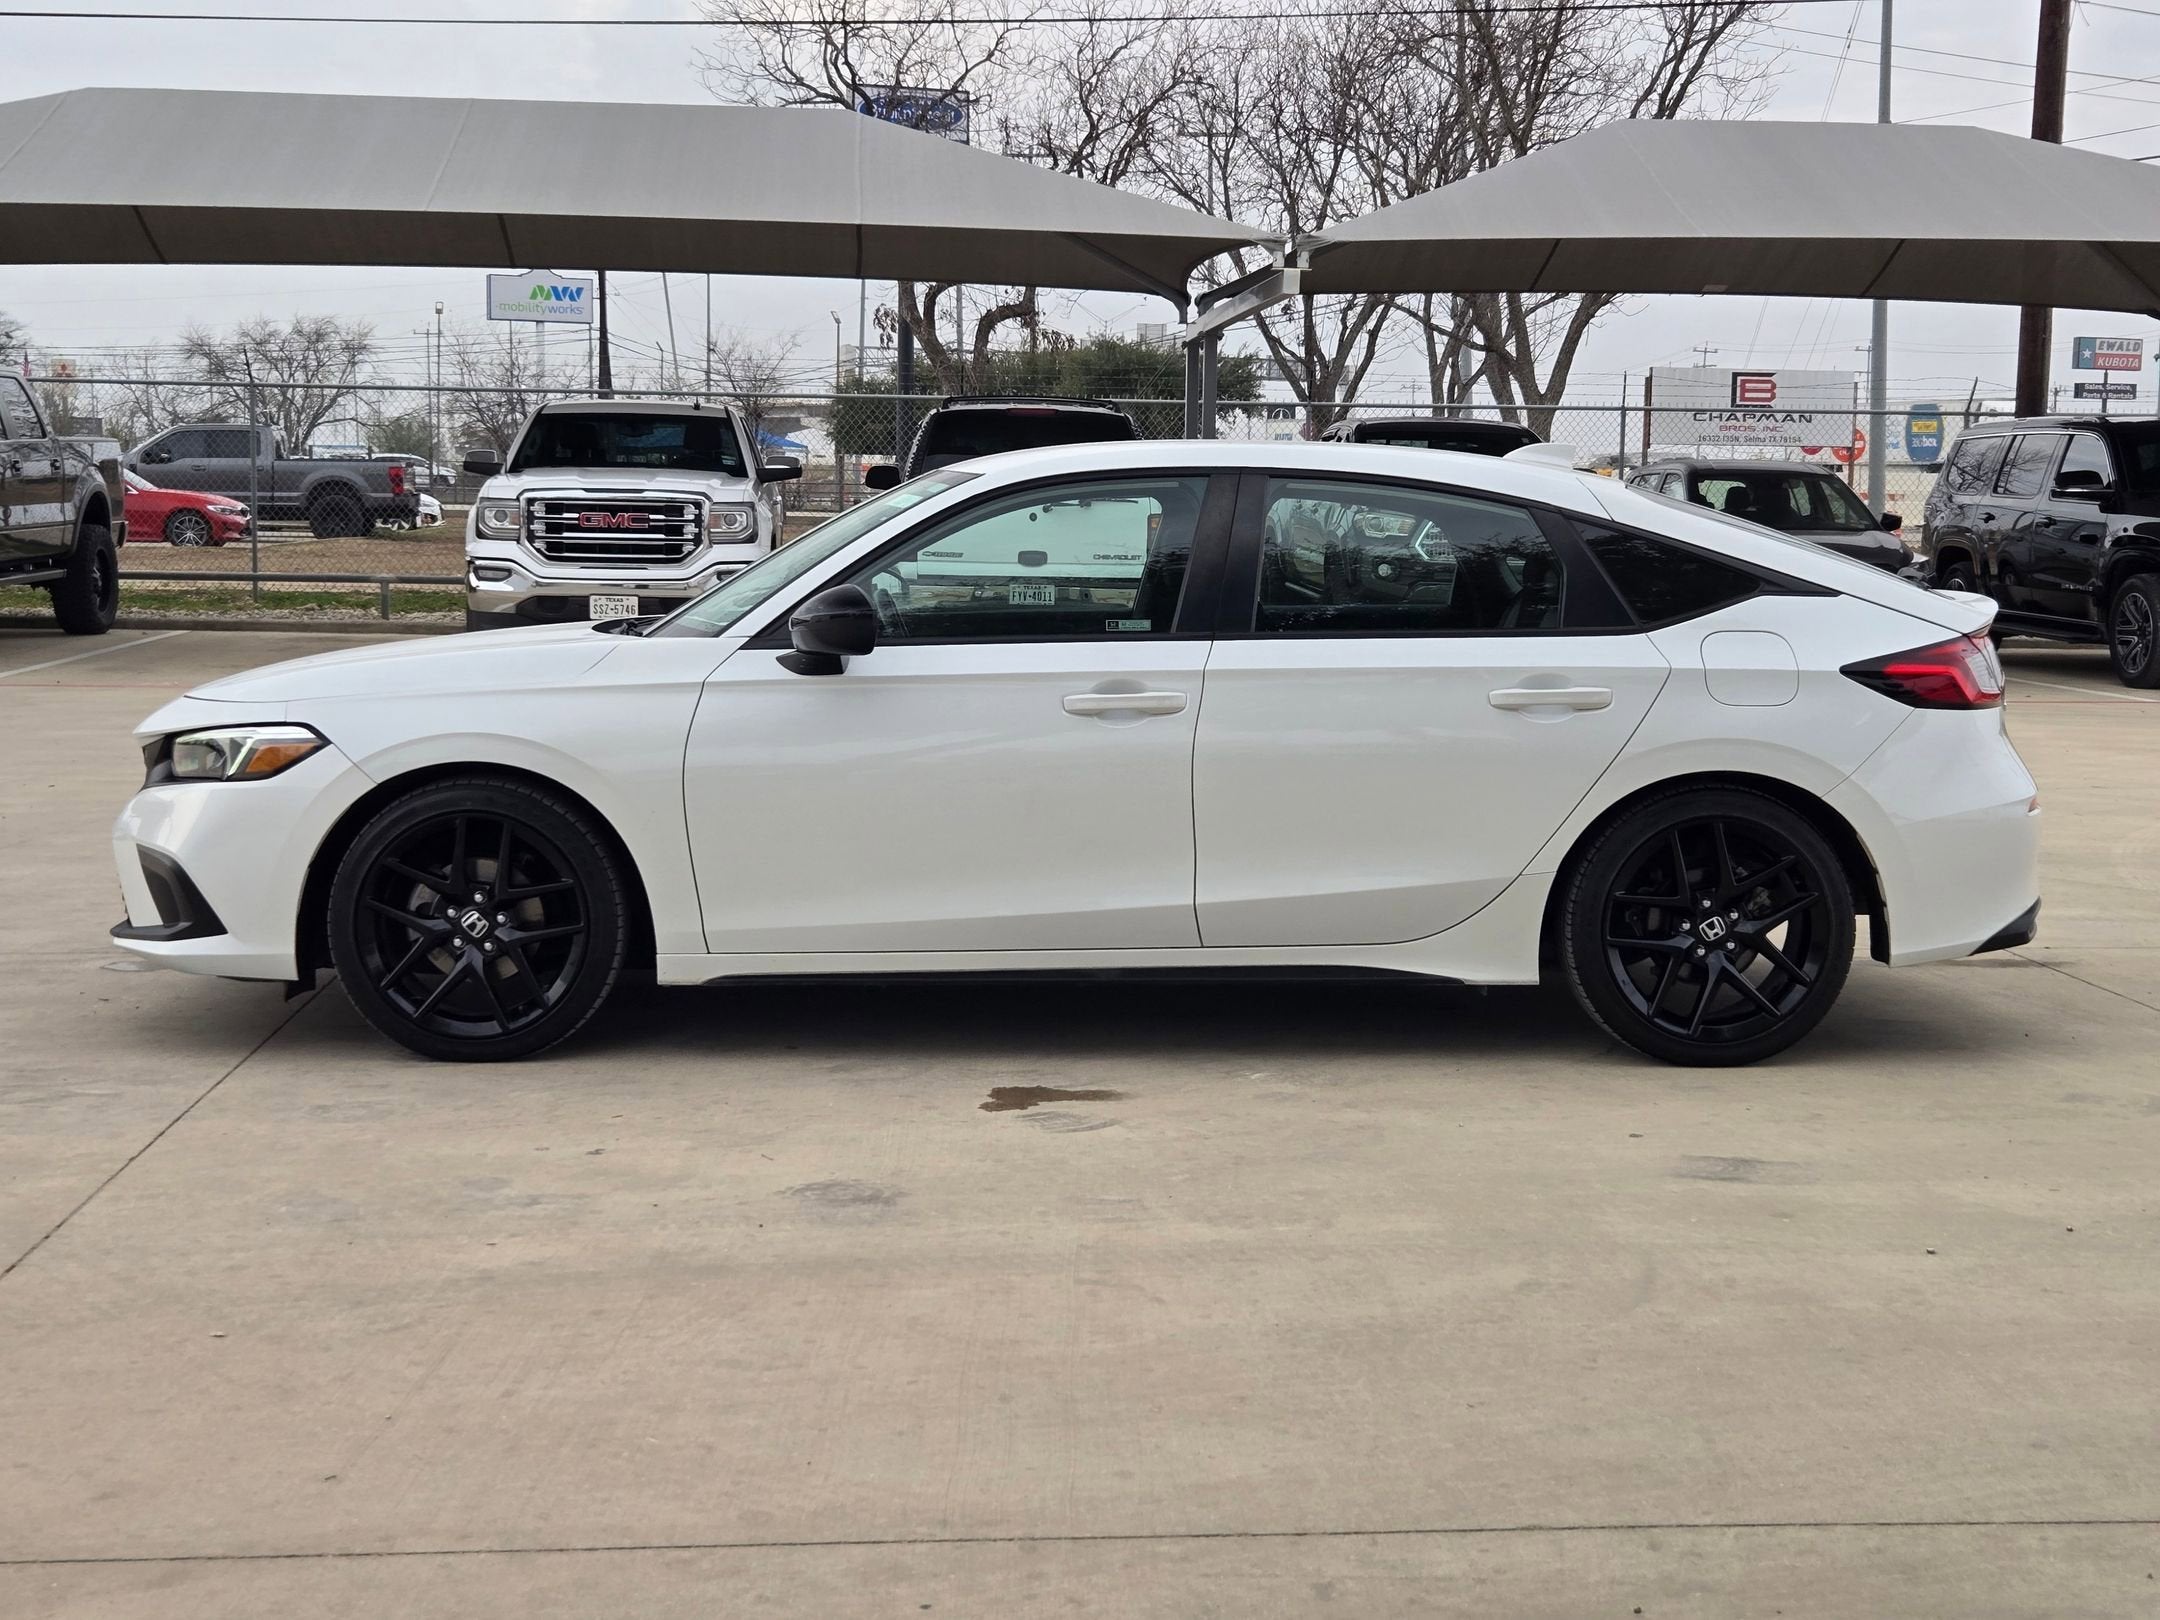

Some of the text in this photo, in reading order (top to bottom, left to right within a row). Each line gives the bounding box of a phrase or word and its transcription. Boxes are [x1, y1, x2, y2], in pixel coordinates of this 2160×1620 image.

[499, 302, 584, 315] mobilityworks
[2098, 340, 2141, 352] EWALD
[2097, 356, 2139, 367] KUBOTA
[1693, 412, 1813, 423] CHAPMAN
[1698, 434, 1720, 442] 16332
[1743, 434, 1767, 443] Selma
[579, 512, 649, 528] GMC
